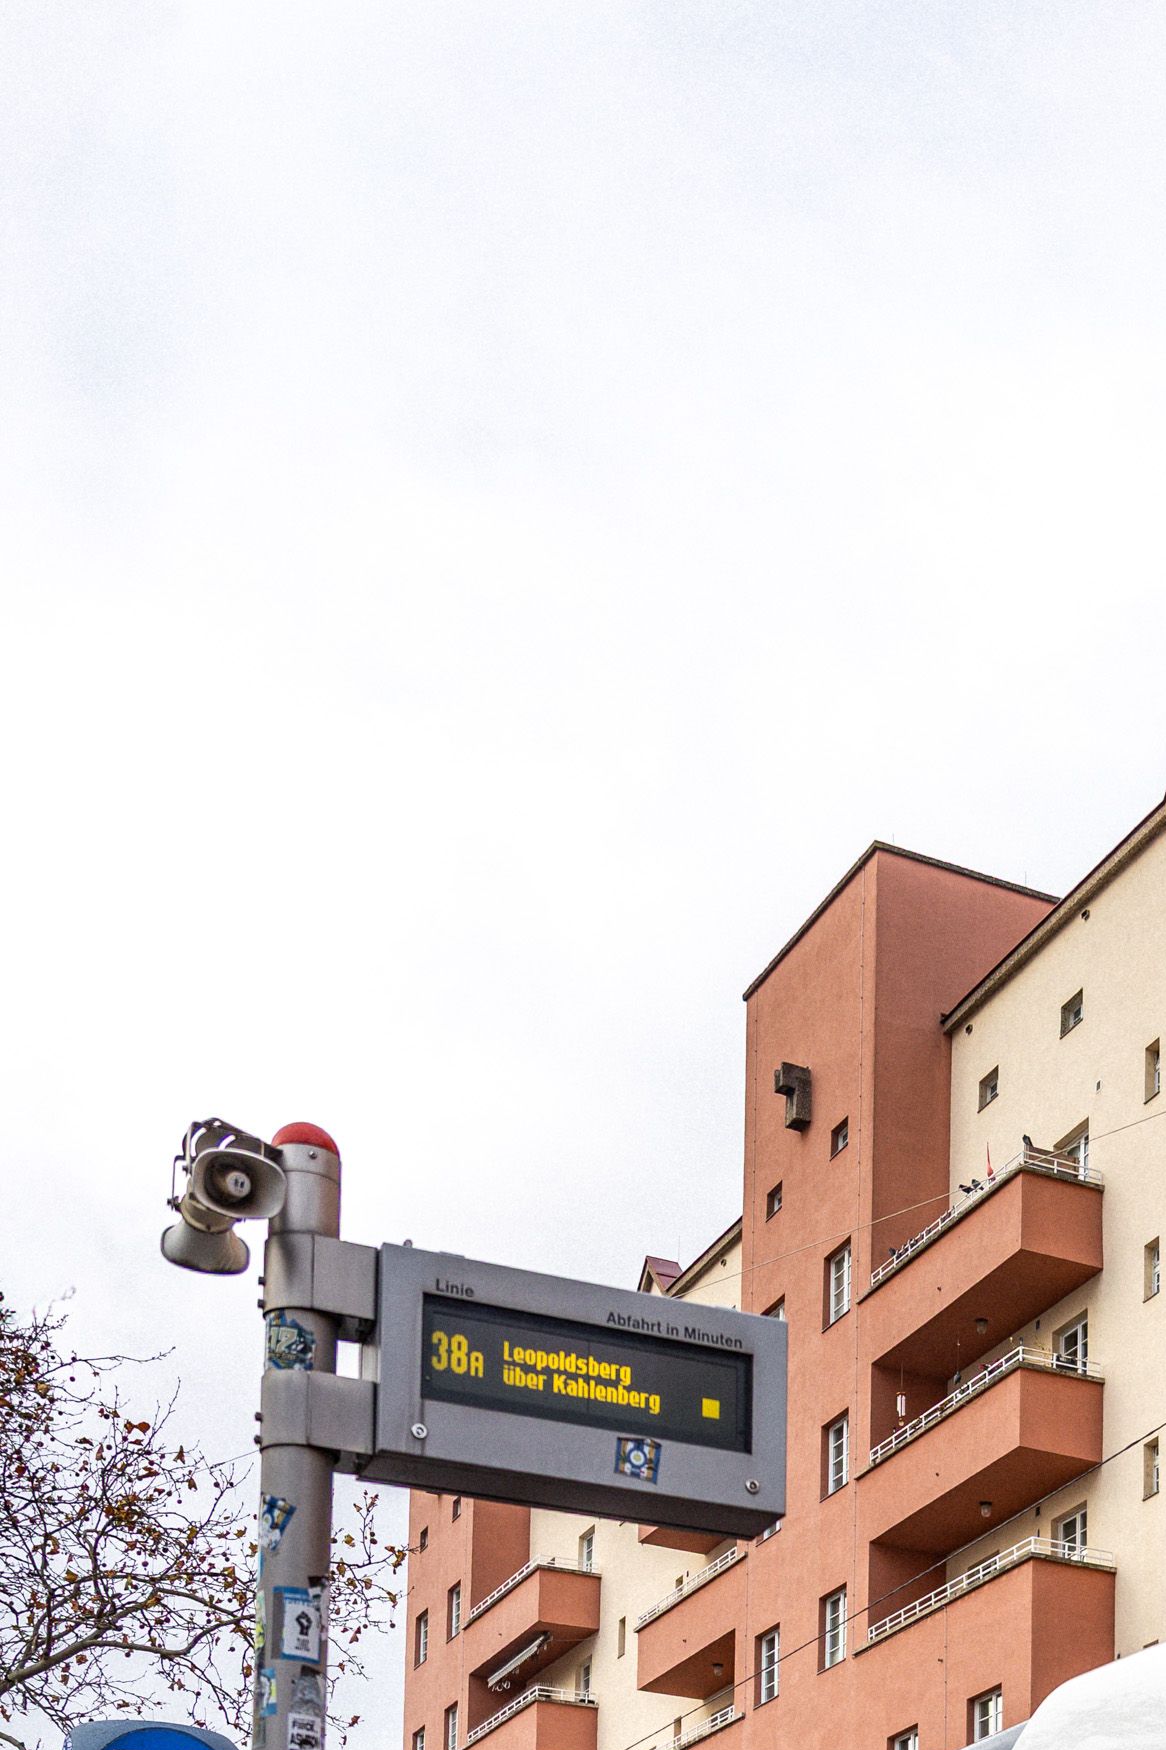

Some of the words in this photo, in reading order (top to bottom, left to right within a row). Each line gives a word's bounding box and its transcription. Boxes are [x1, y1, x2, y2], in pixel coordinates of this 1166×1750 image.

[435, 1278, 474, 1298] Linie
[606, 1311, 663, 1336] Abfahrt
[665, 1321, 681, 1337] in
[683, 1326, 744, 1350] Minuten
[431, 1330, 484, 1379] 38A
[503, 1340, 631, 1386] Leopoldsberg
[503, 1365, 548, 1392] über
[552, 1374, 661, 1416] Kahlenberg
